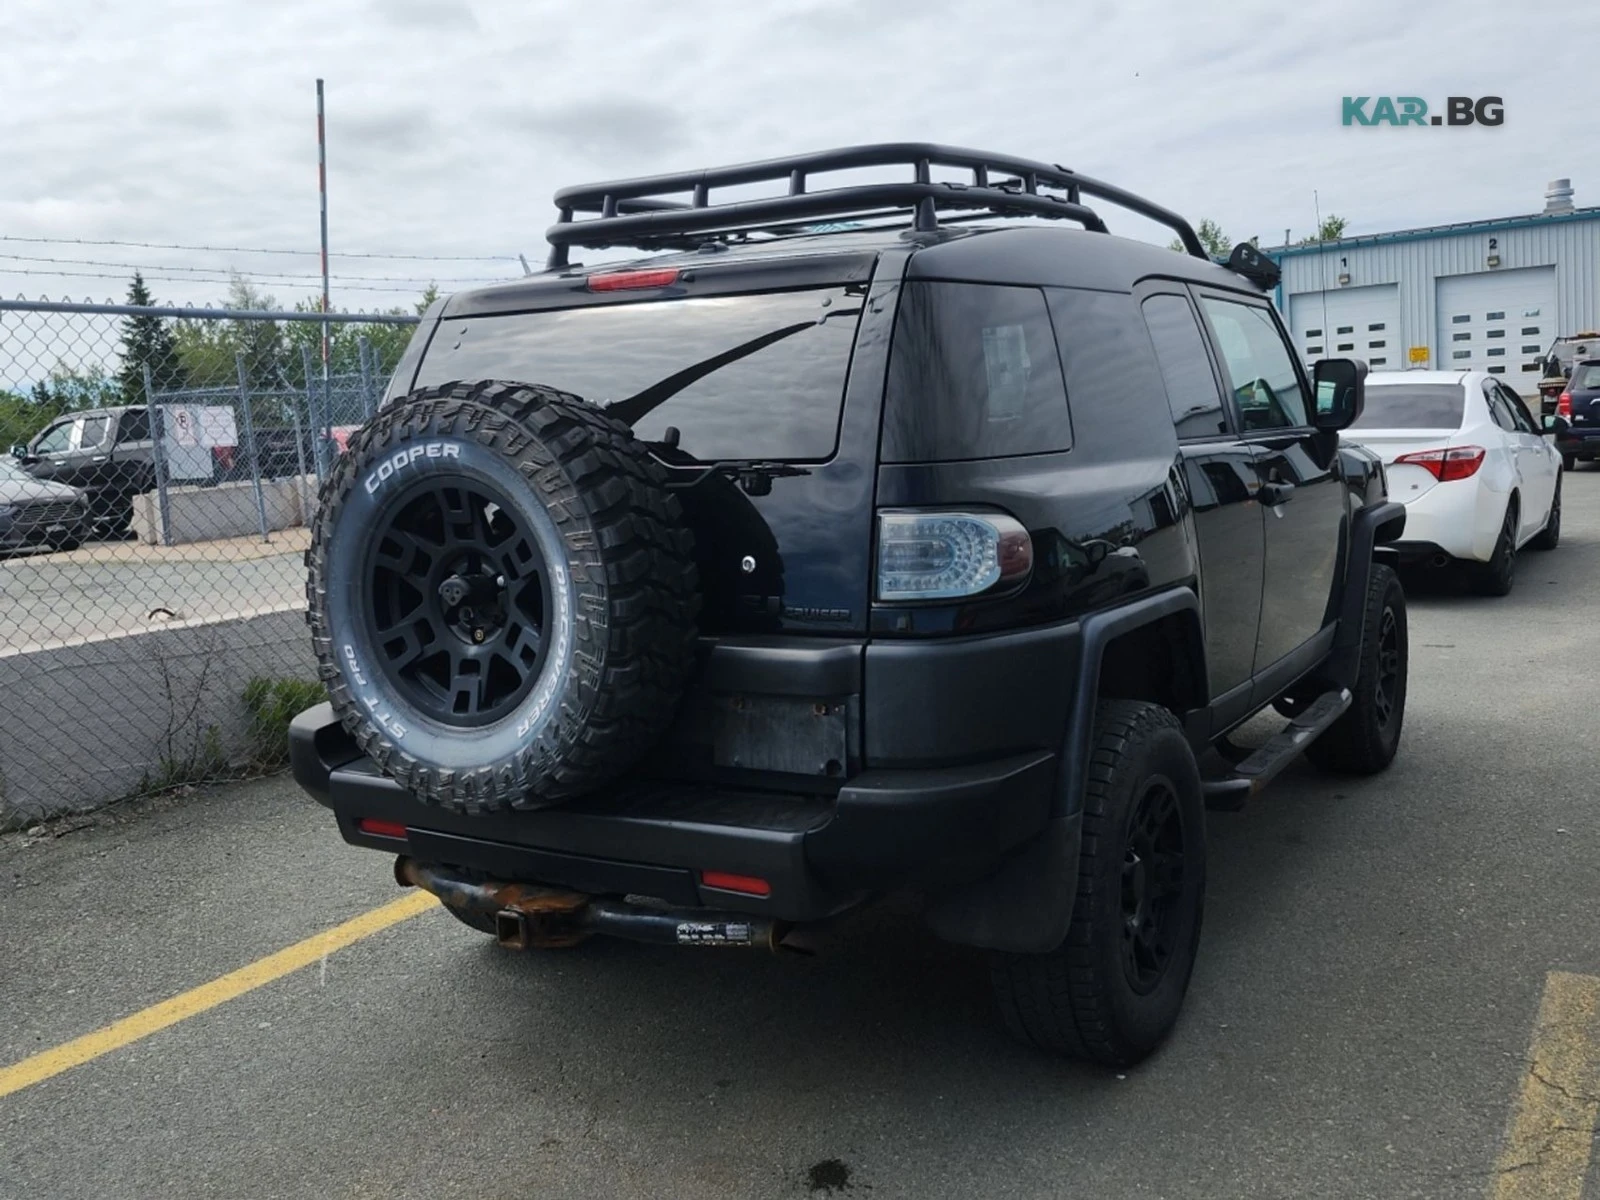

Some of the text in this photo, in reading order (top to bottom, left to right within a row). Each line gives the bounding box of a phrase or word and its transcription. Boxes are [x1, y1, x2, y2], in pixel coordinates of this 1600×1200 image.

[1341, 257, 1348, 268] 1
[1489, 238, 1498, 250] 2
[364, 442, 460, 494] COOPER
[517, 564, 569, 738] DISCOVERER
[343, 643, 407, 739] STT PRO
